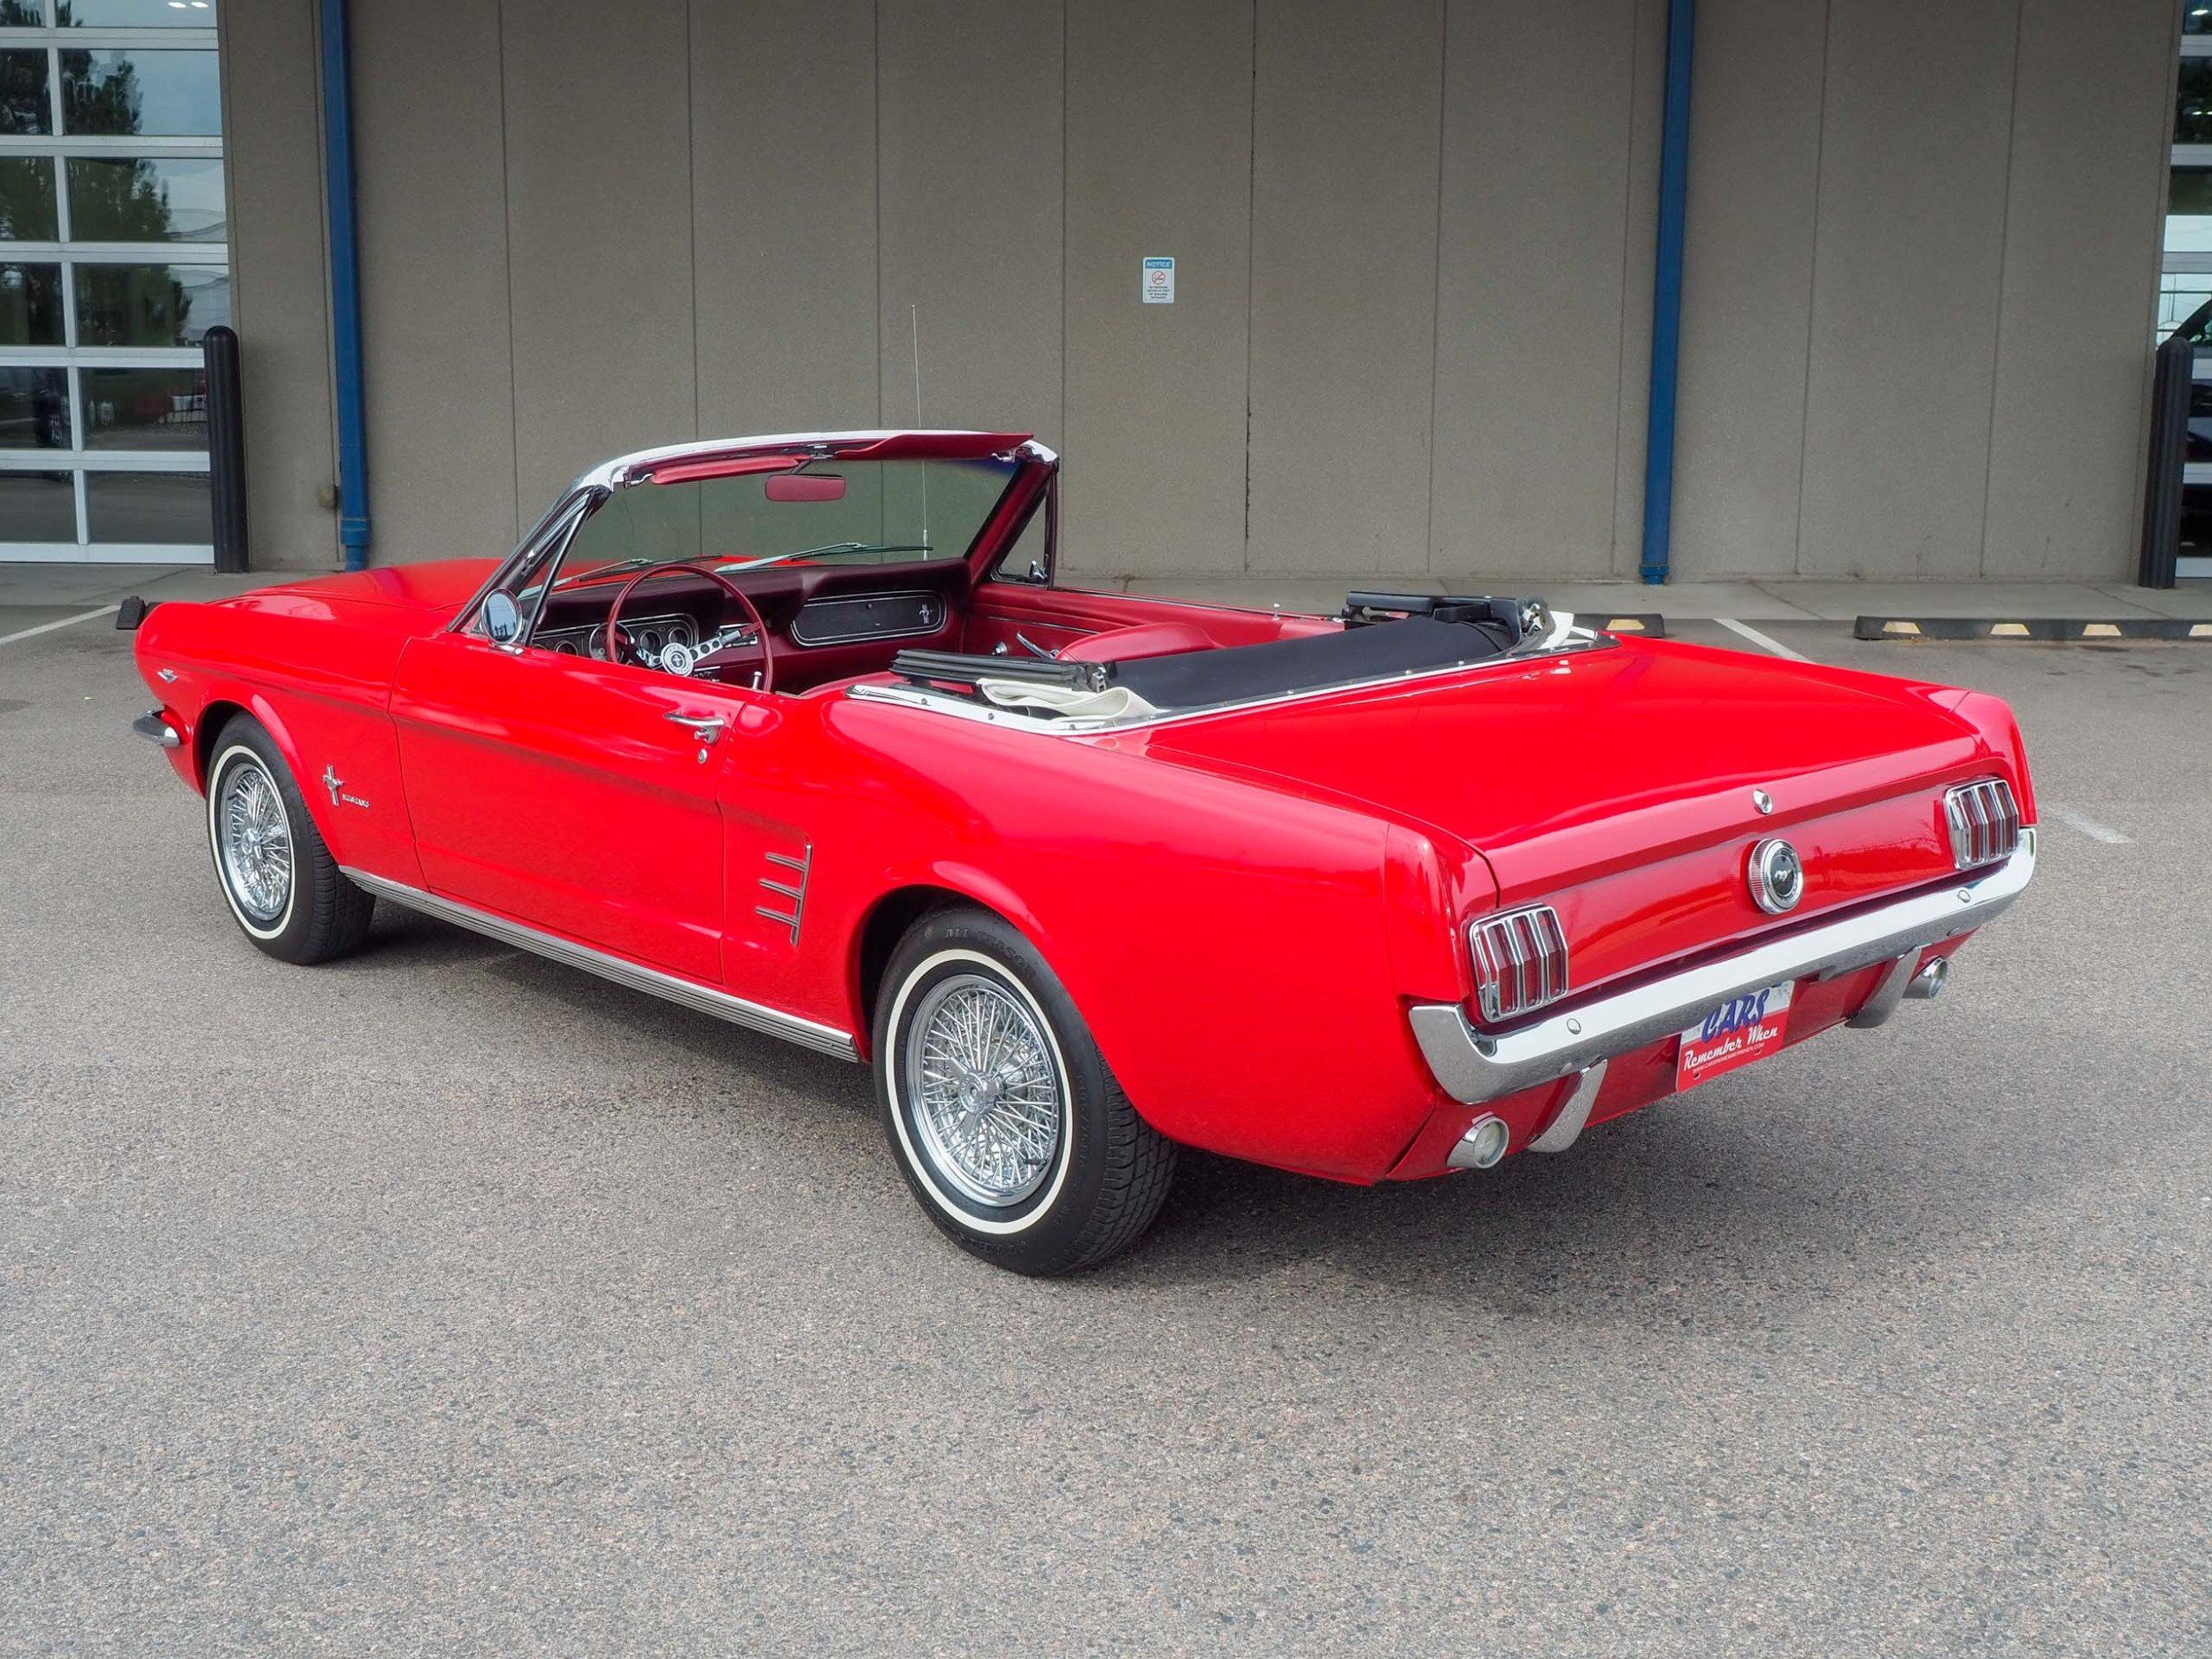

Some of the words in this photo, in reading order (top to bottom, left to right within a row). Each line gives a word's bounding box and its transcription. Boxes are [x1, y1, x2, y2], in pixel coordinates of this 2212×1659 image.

[1701, 987, 1770, 1043] CARS
[1683, 1037, 1743, 1071] Remember
[1747, 1025, 1778, 1045] When
